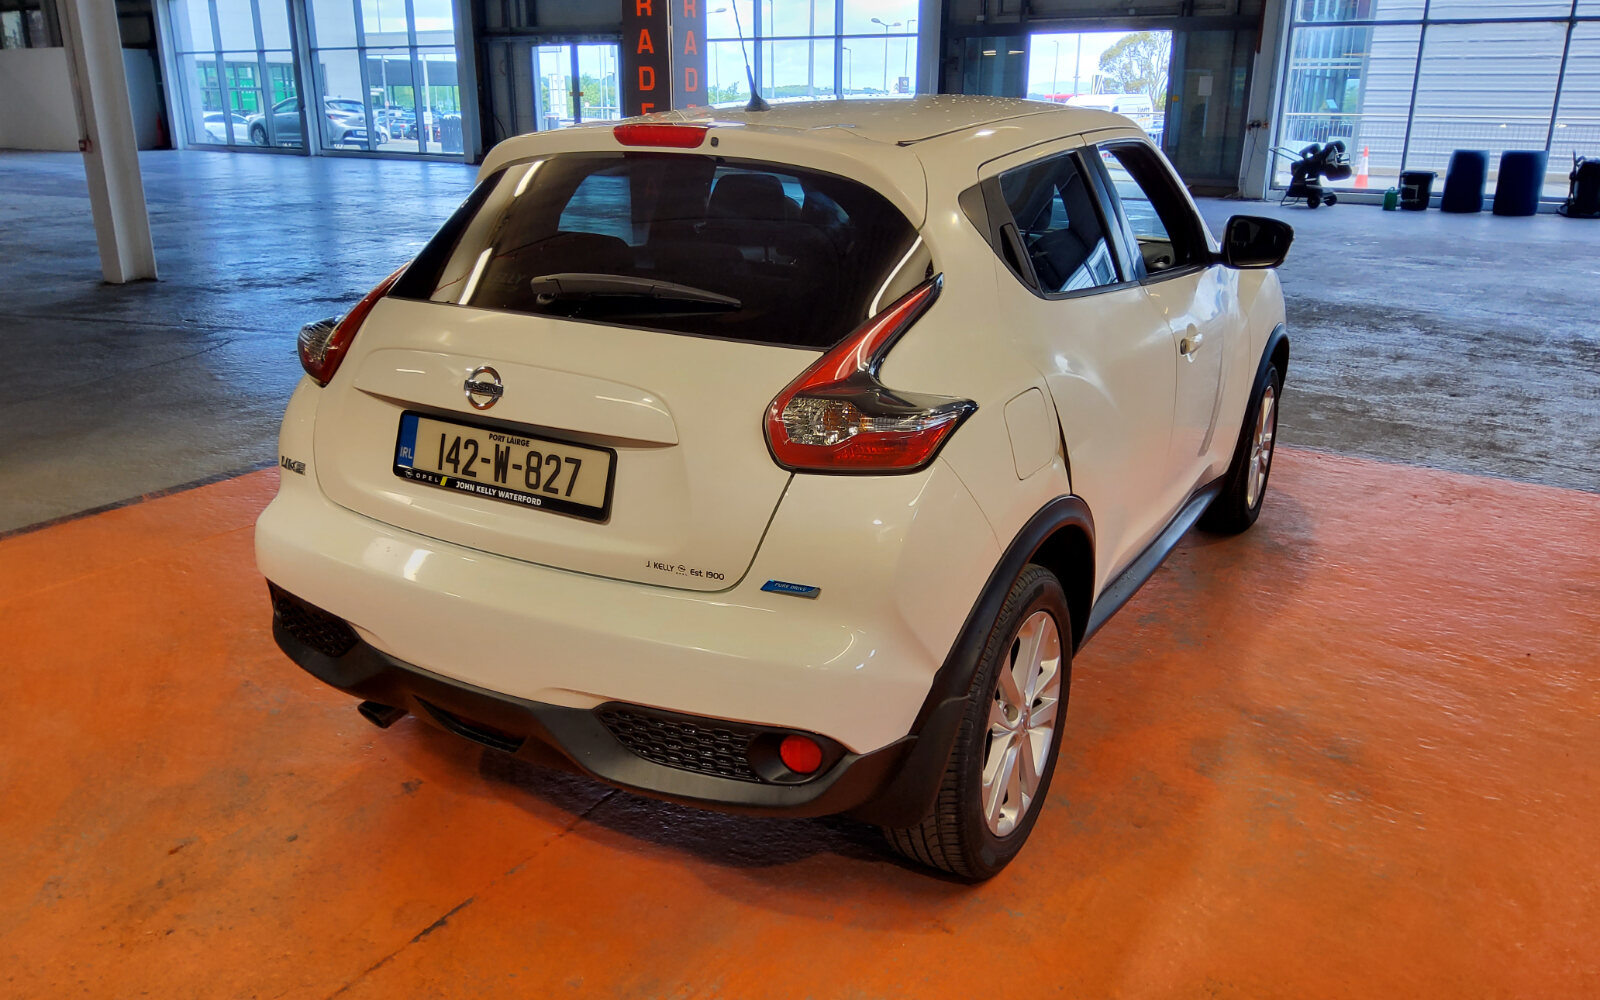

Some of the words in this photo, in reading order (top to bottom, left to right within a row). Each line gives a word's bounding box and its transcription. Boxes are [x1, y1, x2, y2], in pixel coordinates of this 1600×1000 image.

[489, 433, 506, 442] PORT
[400, 446, 413, 459] IRL
[438, 433, 582, 496] 142-W-827
[415, 473, 438, 483] OPEL
[456, 481, 475, 491] JOHN
[476, 485, 496, 496] KELLY
[498, 490, 542, 506] WATERFORD
[653, 562, 675, 572] KELLY
[705, 571, 725, 581] 1900
